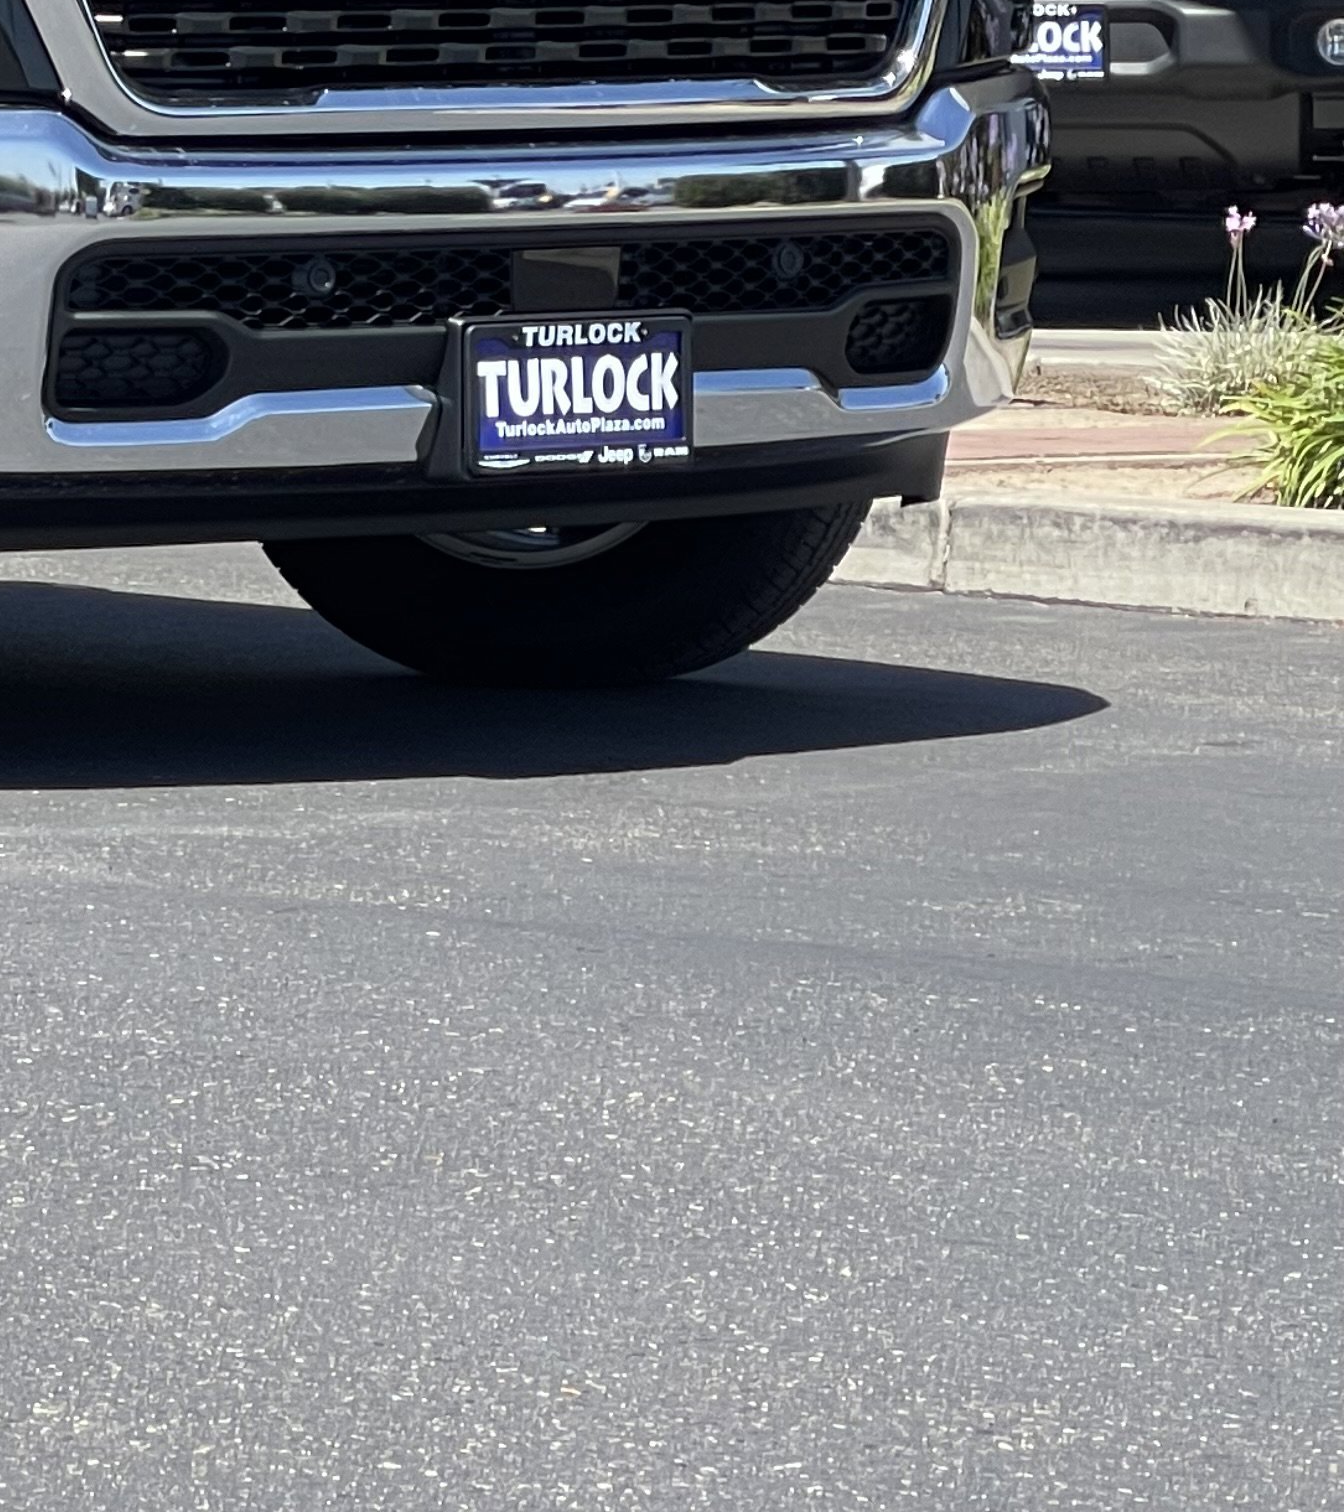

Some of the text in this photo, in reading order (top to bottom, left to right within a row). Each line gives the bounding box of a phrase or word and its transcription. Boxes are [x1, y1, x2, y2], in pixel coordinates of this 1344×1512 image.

[522, 322, 641, 347] TURLOCK
[476, 351, 679, 419] TURLOCK
[495, 416, 666, 438] TurlockAutoPlaza.com
[597, 445, 634, 465] Jeep
[653, 446, 689, 458] RAM
